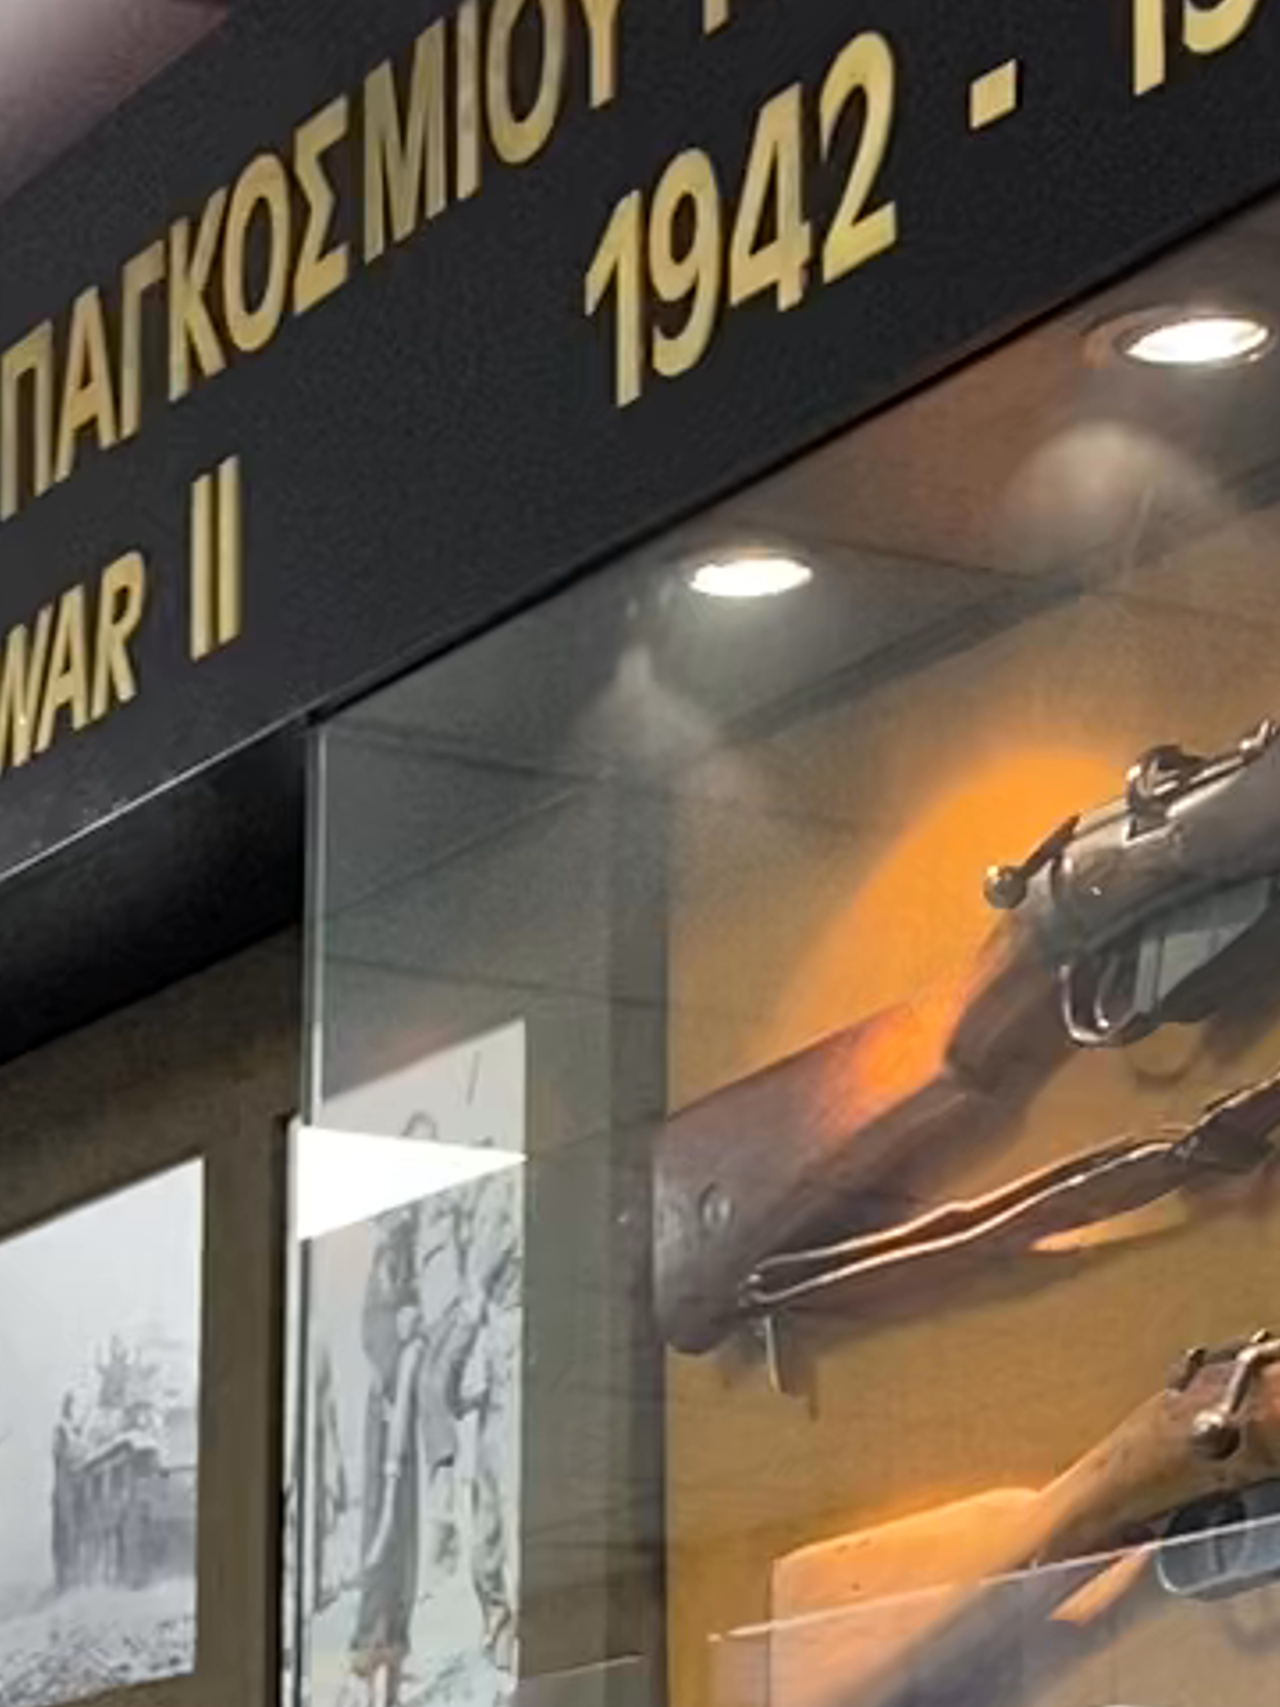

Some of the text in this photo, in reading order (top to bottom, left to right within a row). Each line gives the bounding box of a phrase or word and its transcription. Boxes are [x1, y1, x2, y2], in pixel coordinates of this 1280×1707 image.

[190, 456, 241, 662] II
[585, 31, 897, 408] 1942
[969, 59, 1018, 130] -
